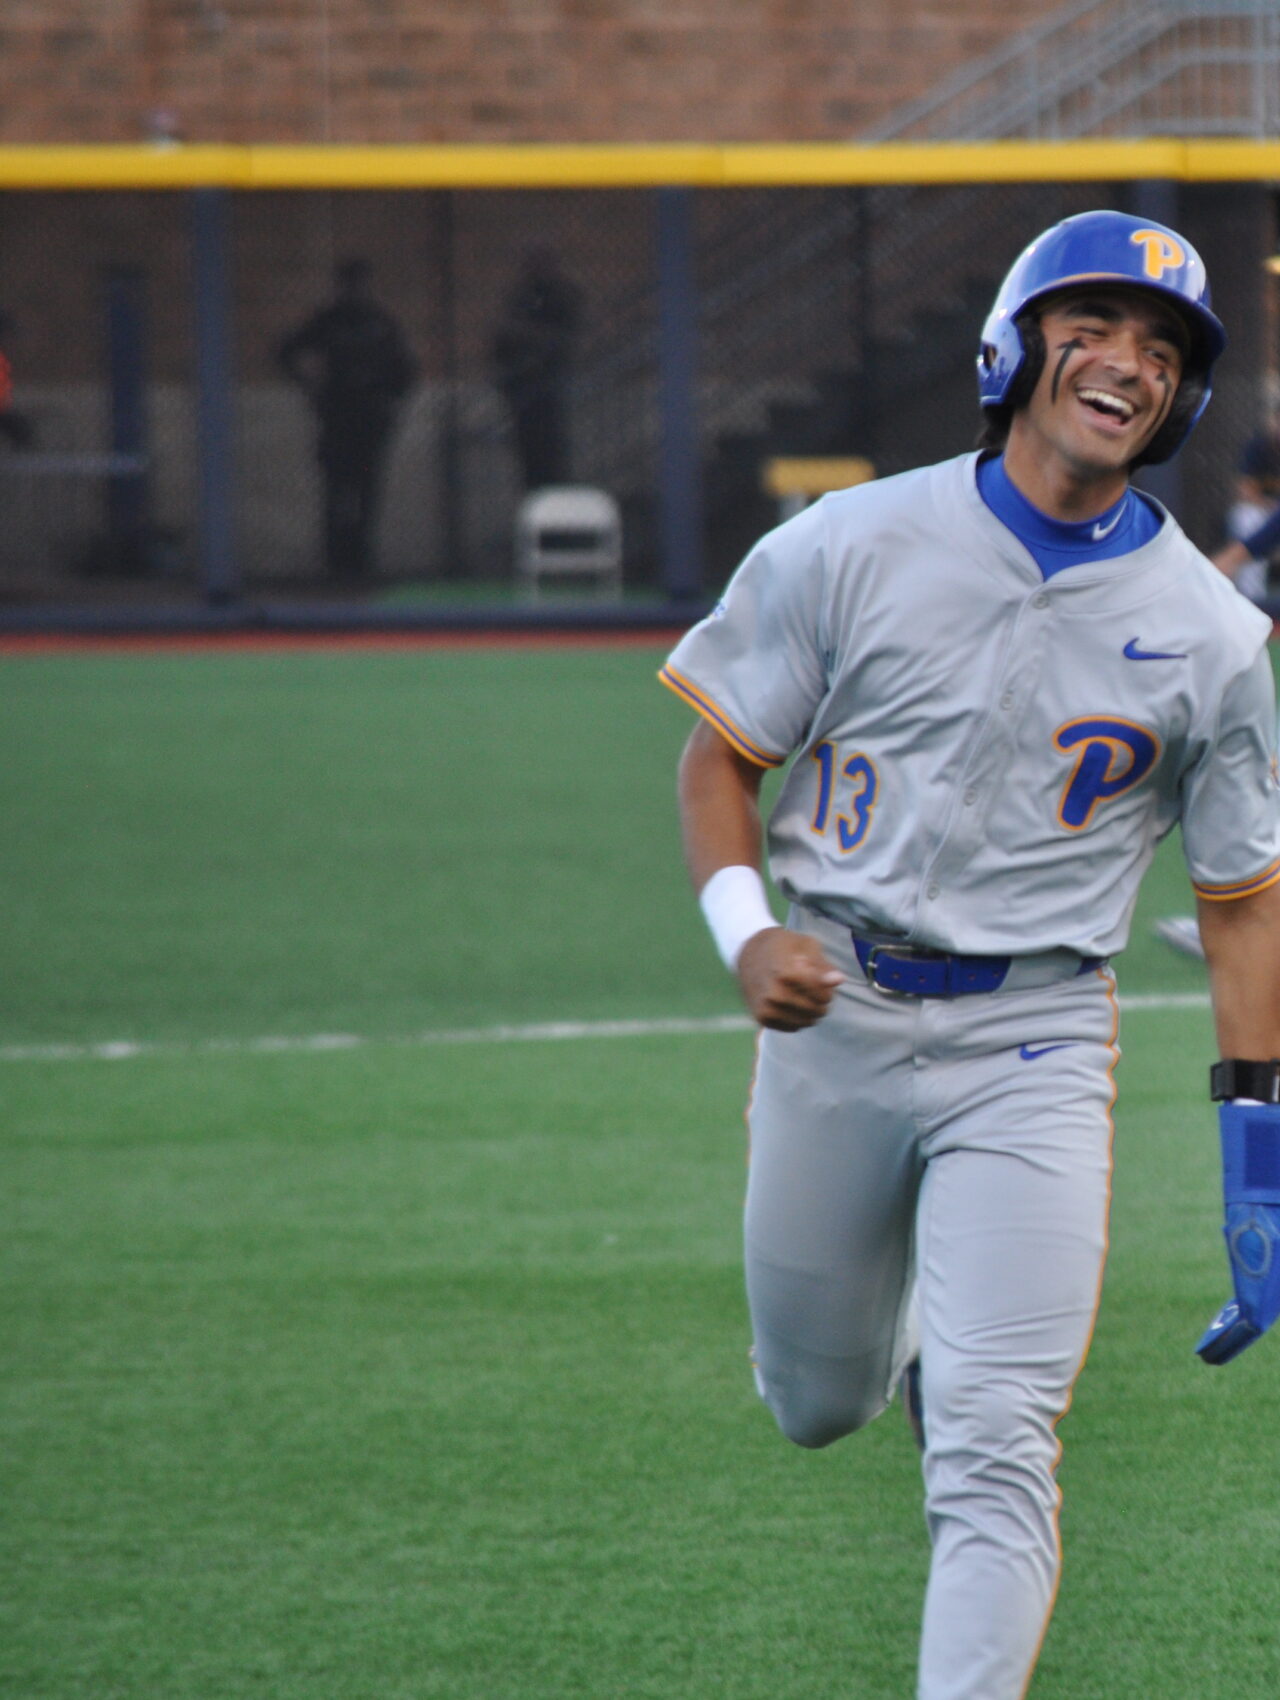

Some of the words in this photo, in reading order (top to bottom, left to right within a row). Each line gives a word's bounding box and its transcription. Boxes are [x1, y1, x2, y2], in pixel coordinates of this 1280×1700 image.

[1131, 229, 1185, 279] P
[811, 741, 880, 854] 13
[1053, 716, 1160, 831] P
